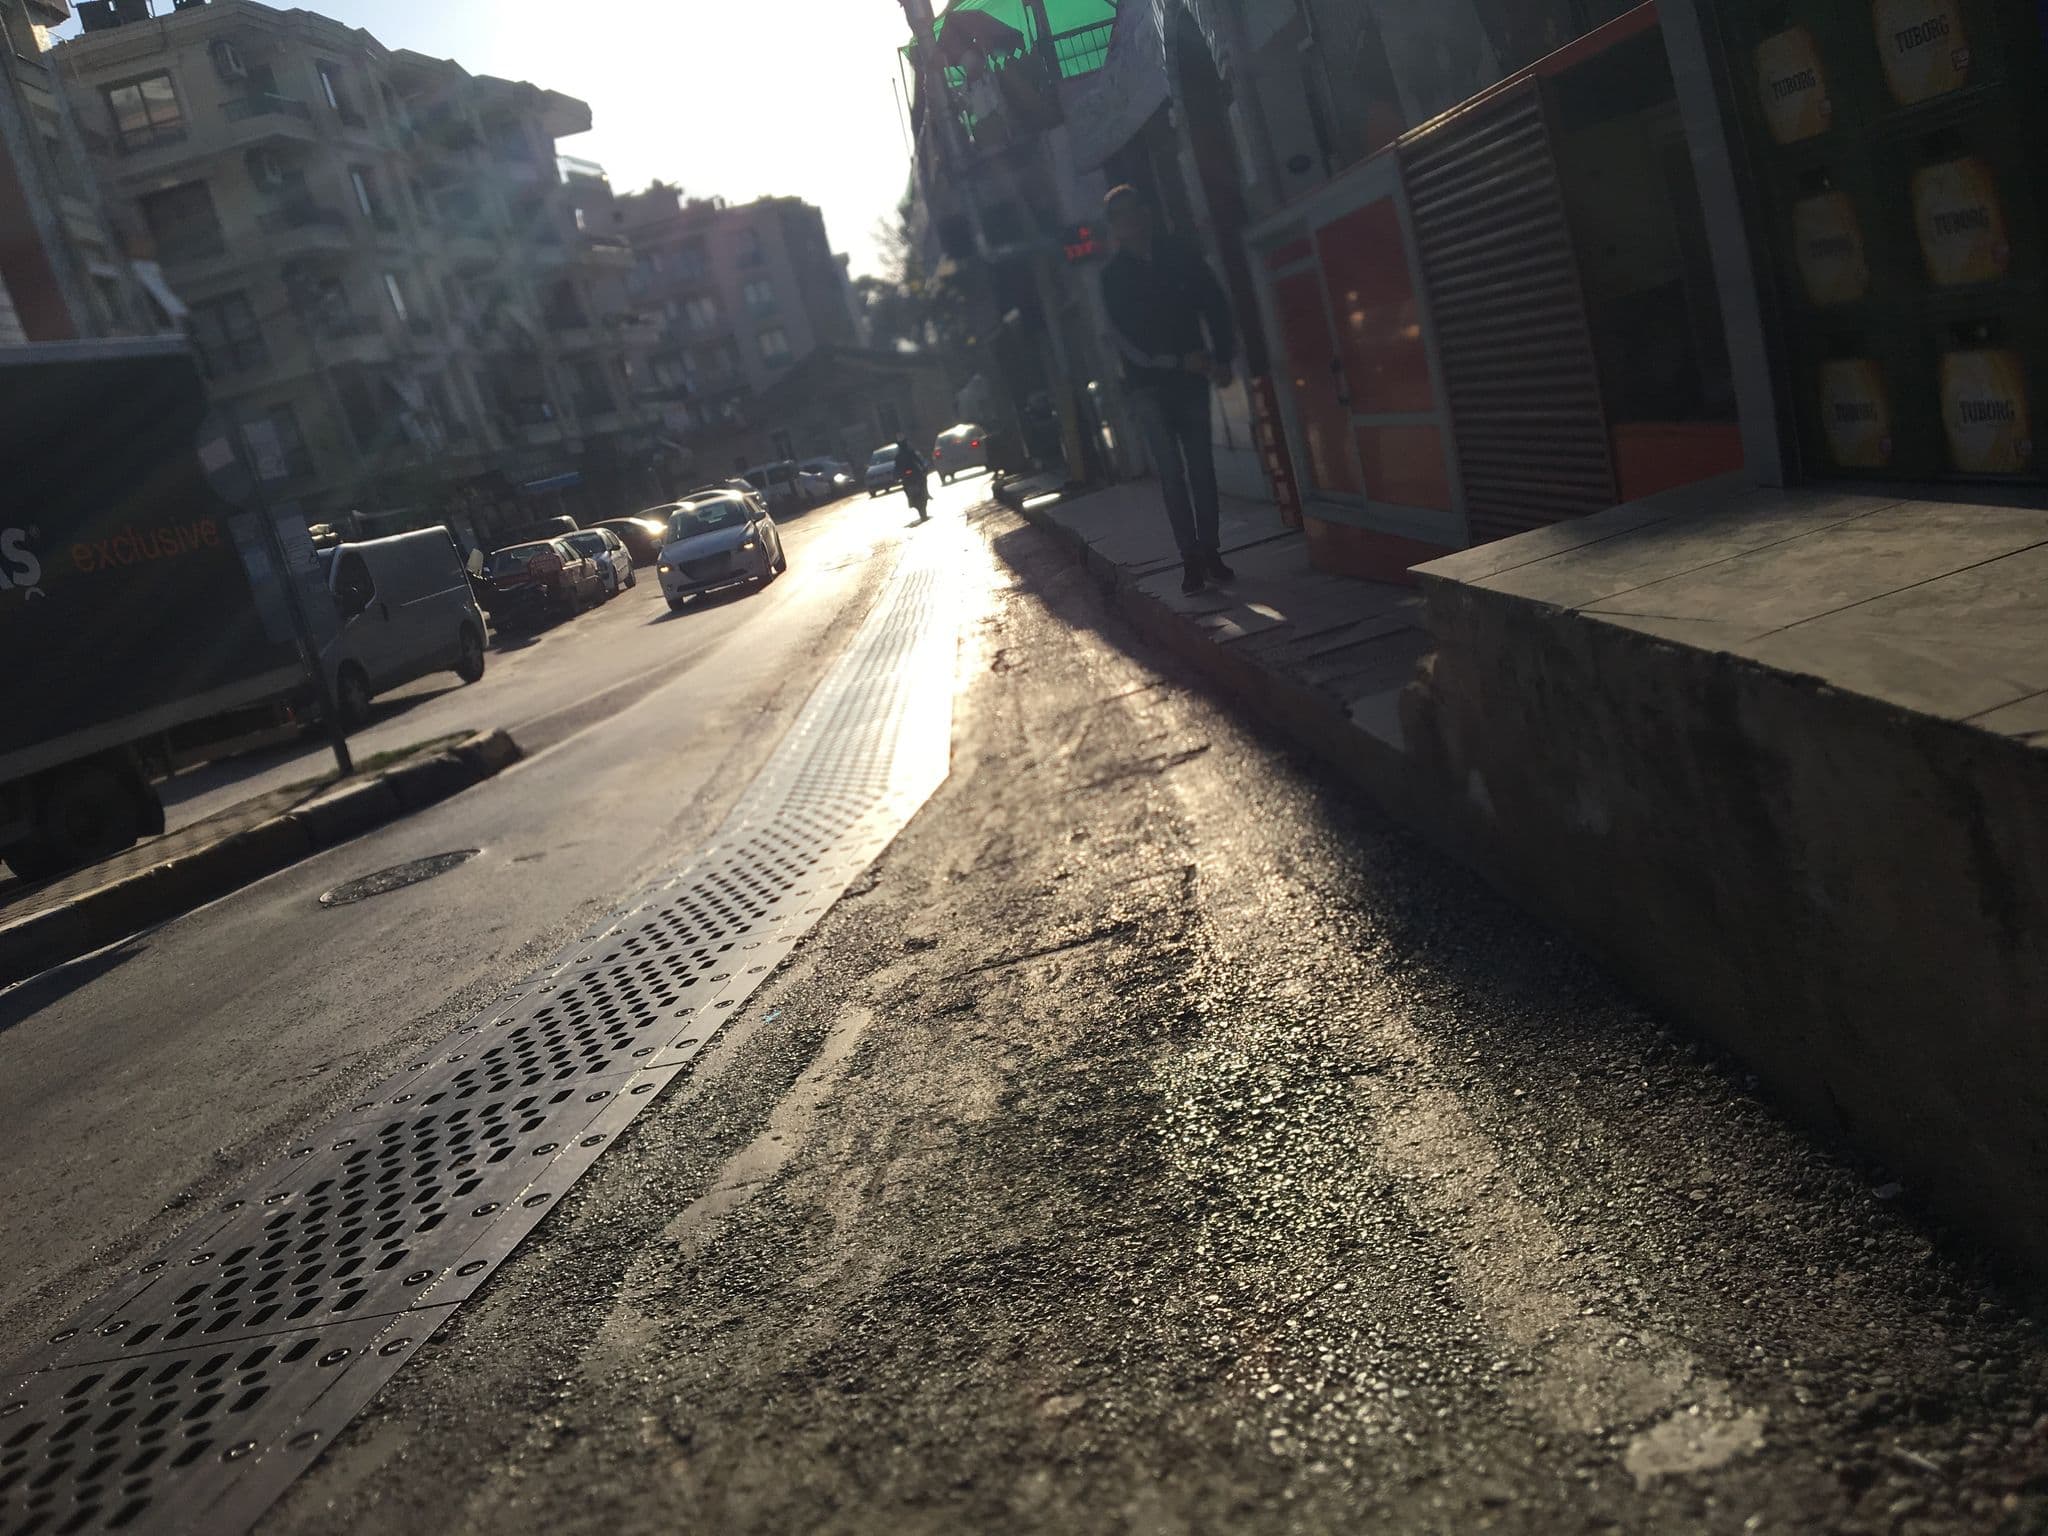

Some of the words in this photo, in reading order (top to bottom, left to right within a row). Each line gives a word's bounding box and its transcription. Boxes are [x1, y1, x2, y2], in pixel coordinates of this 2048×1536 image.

[1894, 13, 1950, 54] TUBORG
[1772, 68, 1816, 99] TUBORG
[1959, 399, 2015, 424] TUBORG
[71, 515, 219, 574] exclusive
